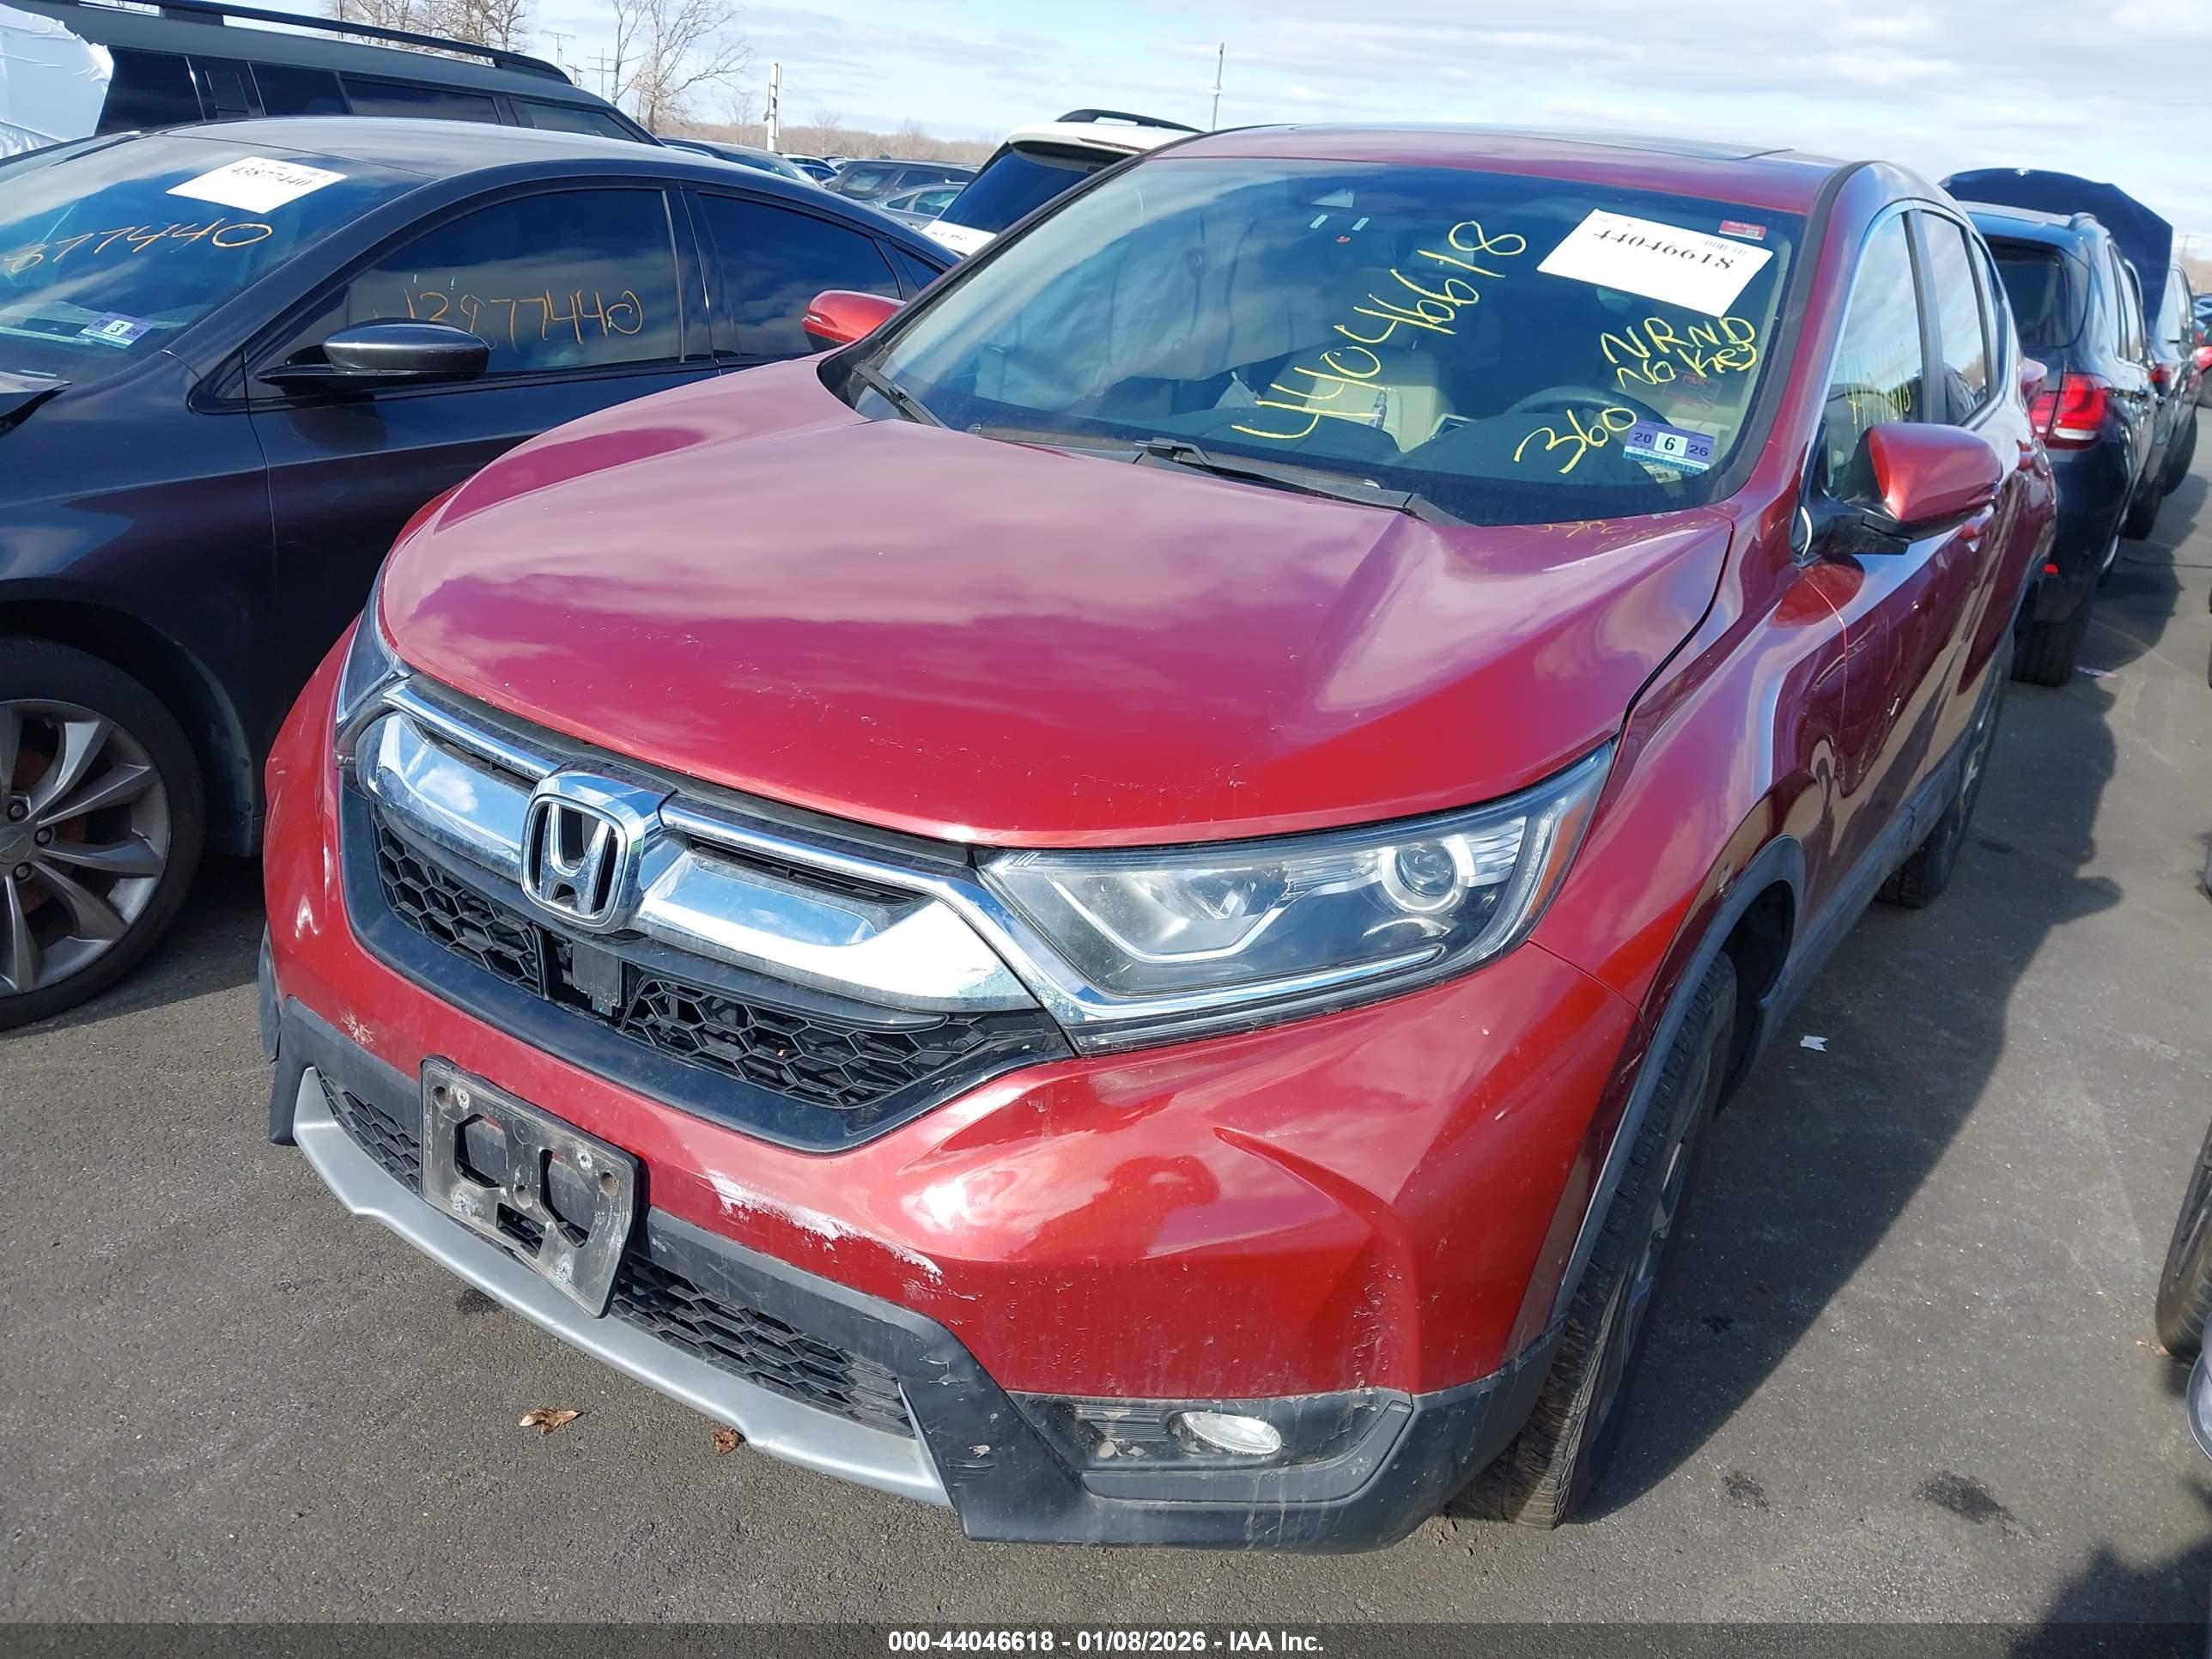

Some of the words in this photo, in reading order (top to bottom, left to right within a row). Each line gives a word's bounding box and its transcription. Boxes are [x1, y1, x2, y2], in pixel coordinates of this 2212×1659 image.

[1593, 229, 1735, 270] 44046618
[110, 323, 125, 333] 3
[1231, 220, 1527, 439] 44046618
[1512, 406, 1638, 474] 360
[1634, 432, 1653, 444] 20
[1663, 436, 1677, 451] 6
[1688, 444, 1709, 457] 26
